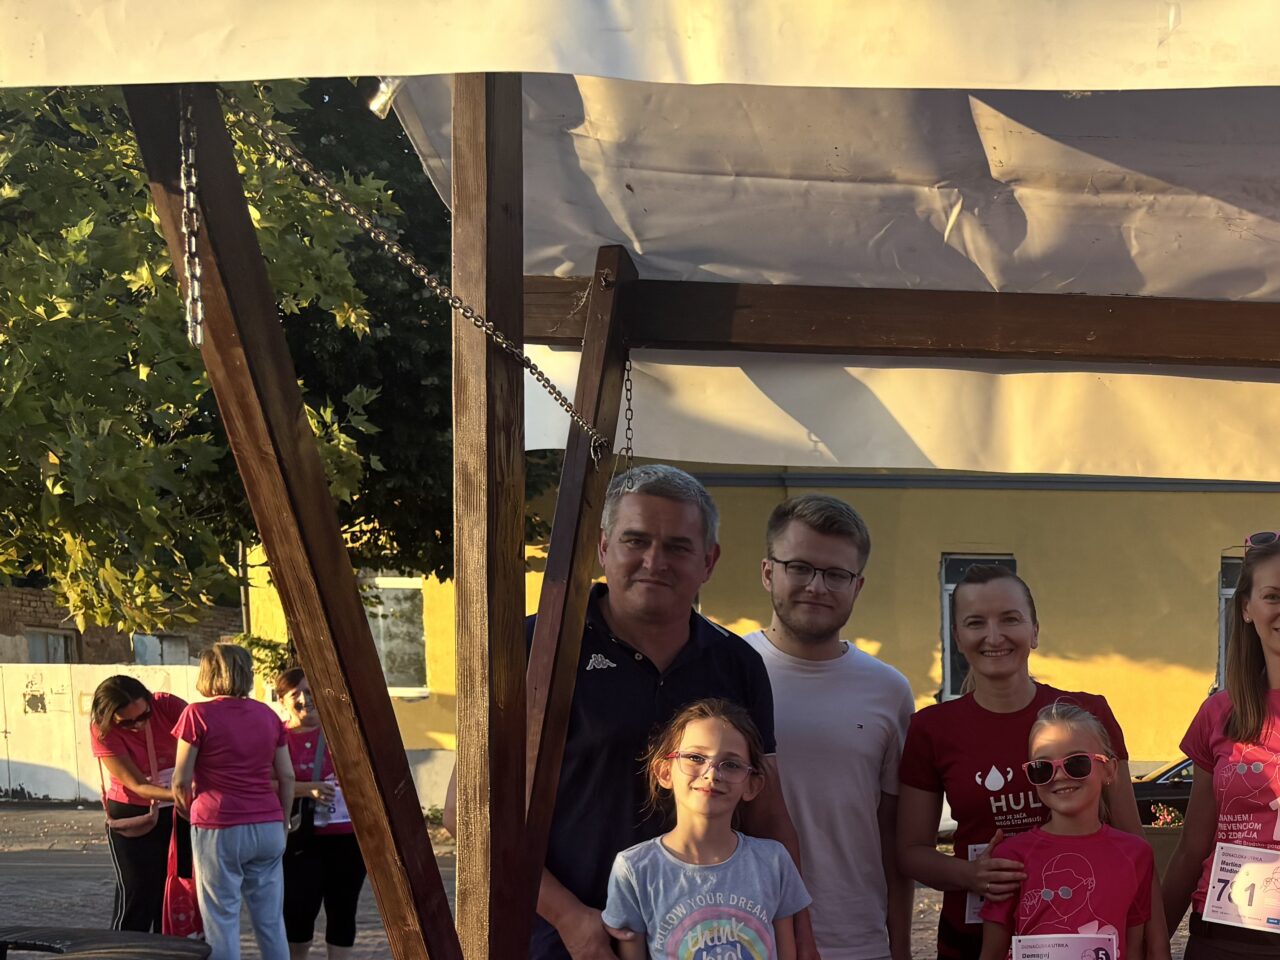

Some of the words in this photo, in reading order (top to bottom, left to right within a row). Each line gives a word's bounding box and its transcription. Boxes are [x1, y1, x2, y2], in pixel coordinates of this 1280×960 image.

[989, 791, 1042, 813] HUL
[655, 903, 687, 952] FOLLOW
[688, 892, 724, 909] YOUR
[687, 917, 750, 952] think
